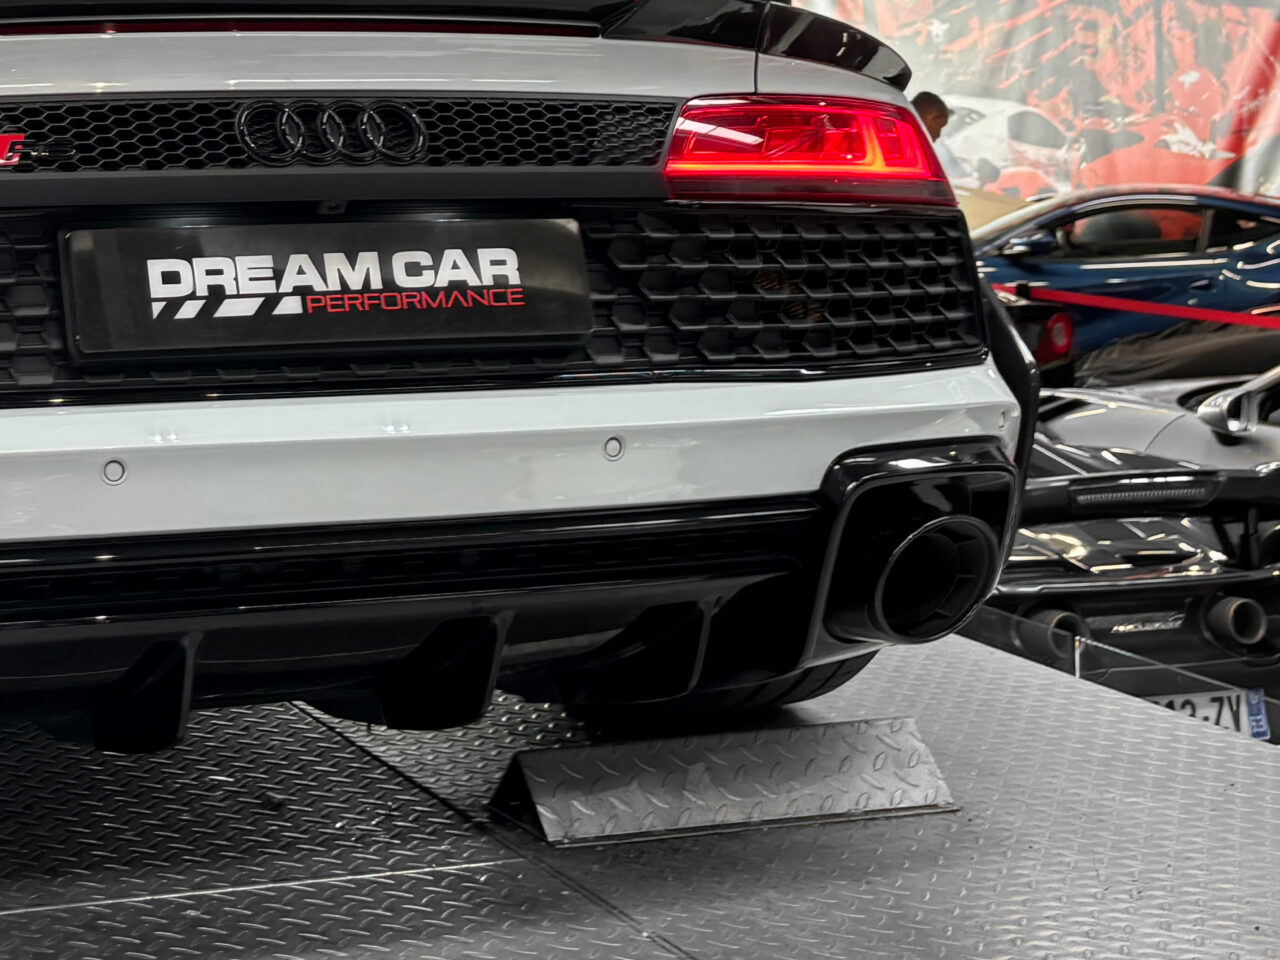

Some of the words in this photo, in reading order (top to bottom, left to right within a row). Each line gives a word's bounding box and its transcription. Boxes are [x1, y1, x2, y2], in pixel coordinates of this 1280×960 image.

[146, 250, 383, 298] DREAM
[392, 248, 521, 289] CAR
[306, 288, 526, 314] PERFORMANCE
